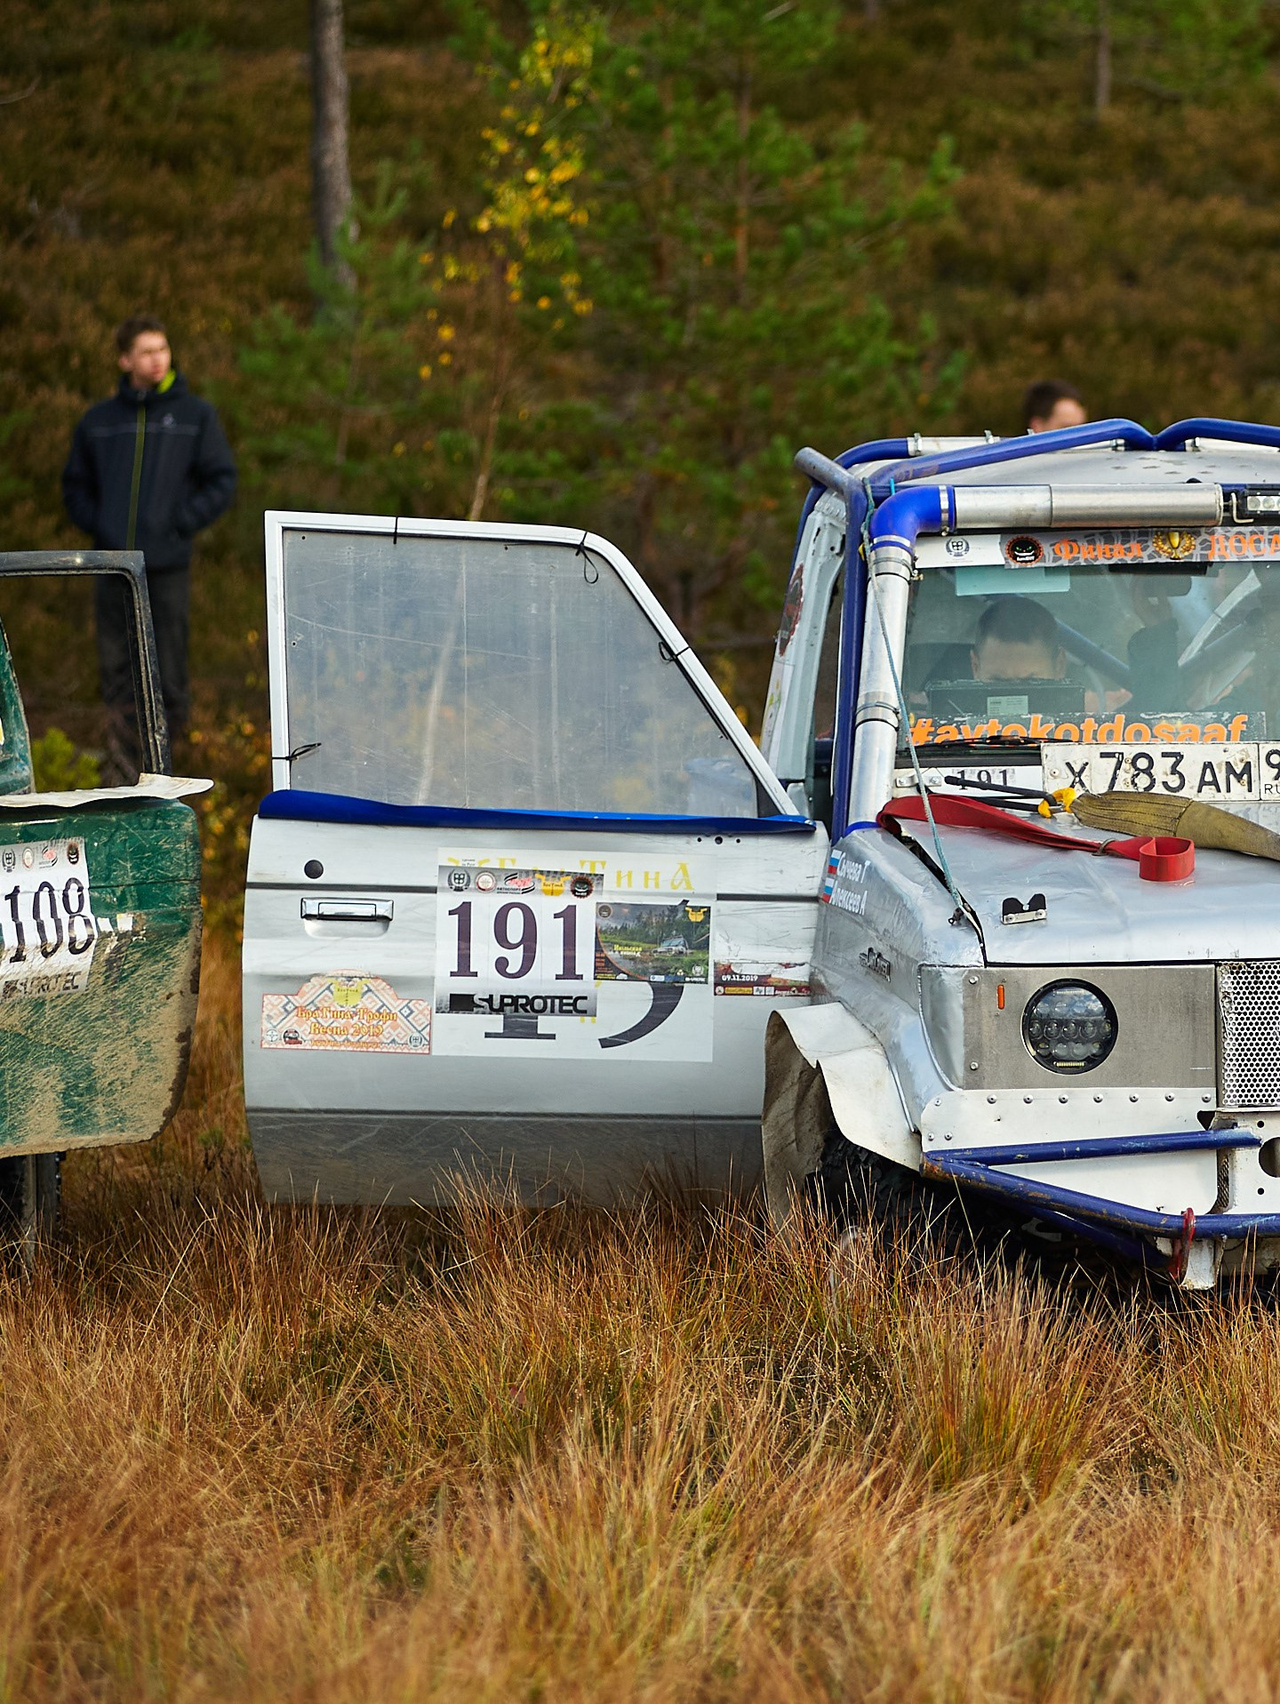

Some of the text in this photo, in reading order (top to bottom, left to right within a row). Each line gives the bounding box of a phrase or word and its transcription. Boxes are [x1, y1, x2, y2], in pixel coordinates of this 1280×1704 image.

[1054, 538, 1143, 560] Финал
[4, 877, 95, 964] 108
[448, 901, 584, 980] 191
[473, 994, 588, 1014] SUPROTEC
